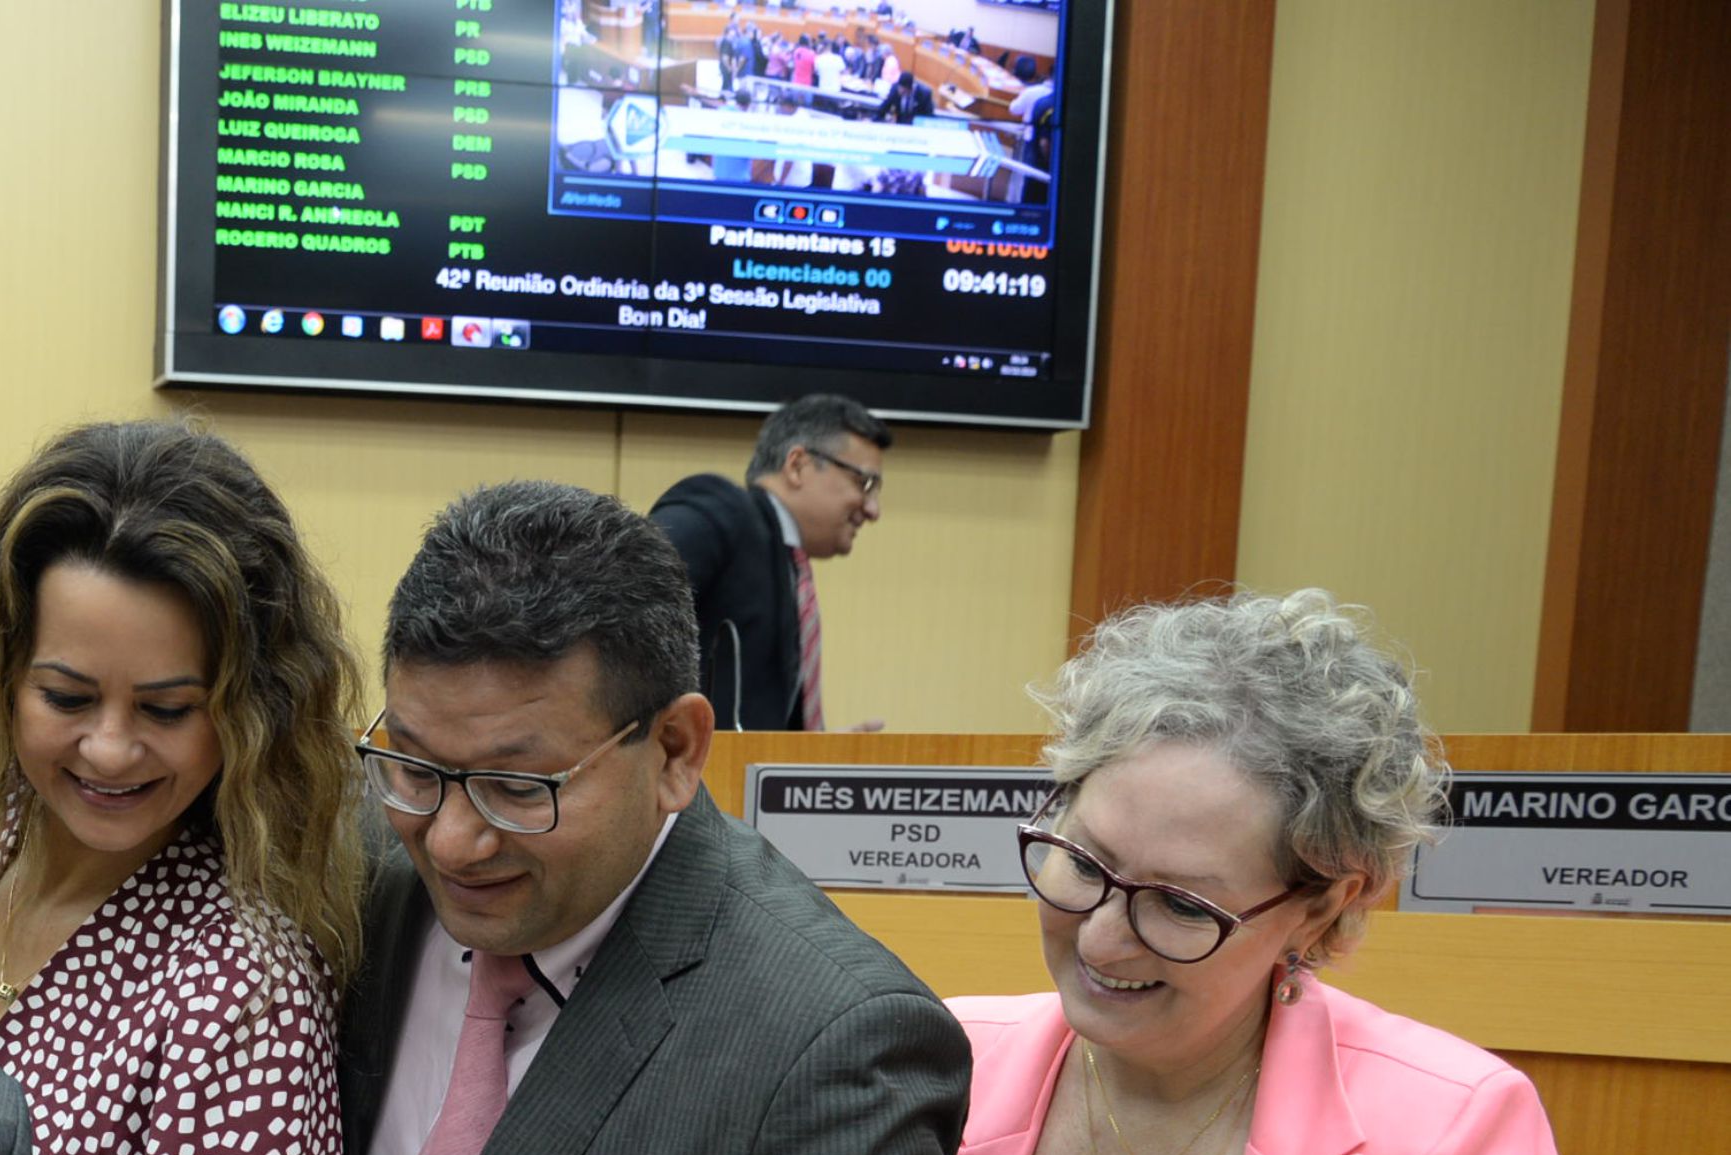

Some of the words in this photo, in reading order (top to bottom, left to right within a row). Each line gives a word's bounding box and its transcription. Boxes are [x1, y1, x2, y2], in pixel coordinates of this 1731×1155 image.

[220, 3, 285, 23] ELIZEU
[288, 8, 380, 30] LIBERATO
[455, 20, 481, 38] PR
[266, 34, 377, 58] WEIZEMANN
[454, 48, 490, 66] PSD
[220, 63, 314, 85] JEFERSON
[318, 70, 406, 92] BRAYNER
[219, 89, 270, 109] JOÃO
[273, 94, 359, 116] MIRANDA
[453, 106, 489, 124] PSD
[218, 119, 261, 138] LUIZ
[217, 147, 291, 168] MARCIO
[294, 152, 346, 172] ROSA
[451, 163, 488, 180] PSD
[217, 175, 291, 195] MARINO
[293, 180, 365, 200] GARCIA
[216, 201, 275, 221] NANCI
[300, 206, 400, 228] ANDREOLA
[449, 215, 486, 233] PDT
[215, 228, 299, 249] ROGERIO
[301, 233, 391, 255] QUADROS
[448, 242, 485, 260] PTB
[710, 224, 865, 256] Parlamentares
[869, 237, 896, 258] 15
[733, 258, 860, 287] Licenciados
[864, 268, 892, 289] 00
[943, 268, 1047, 298] 09:41:19
[475, 269, 557, 294] Reunião
[560, 275, 650, 300] Ordinária
[653, 280, 680, 301] da
[709, 283, 779, 308] Sessão
[782, 288, 881, 315] Legislativa
[668, 307, 707, 330] Dia!
[783, 781, 854, 810] INÊS
[1463, 791, 1616, 820] MARINO
[890, 823, 941, 843] PSD
[848, 850, 981, 869] VEREADORA
[1541, 867, 1688, 888] VEREADOR
